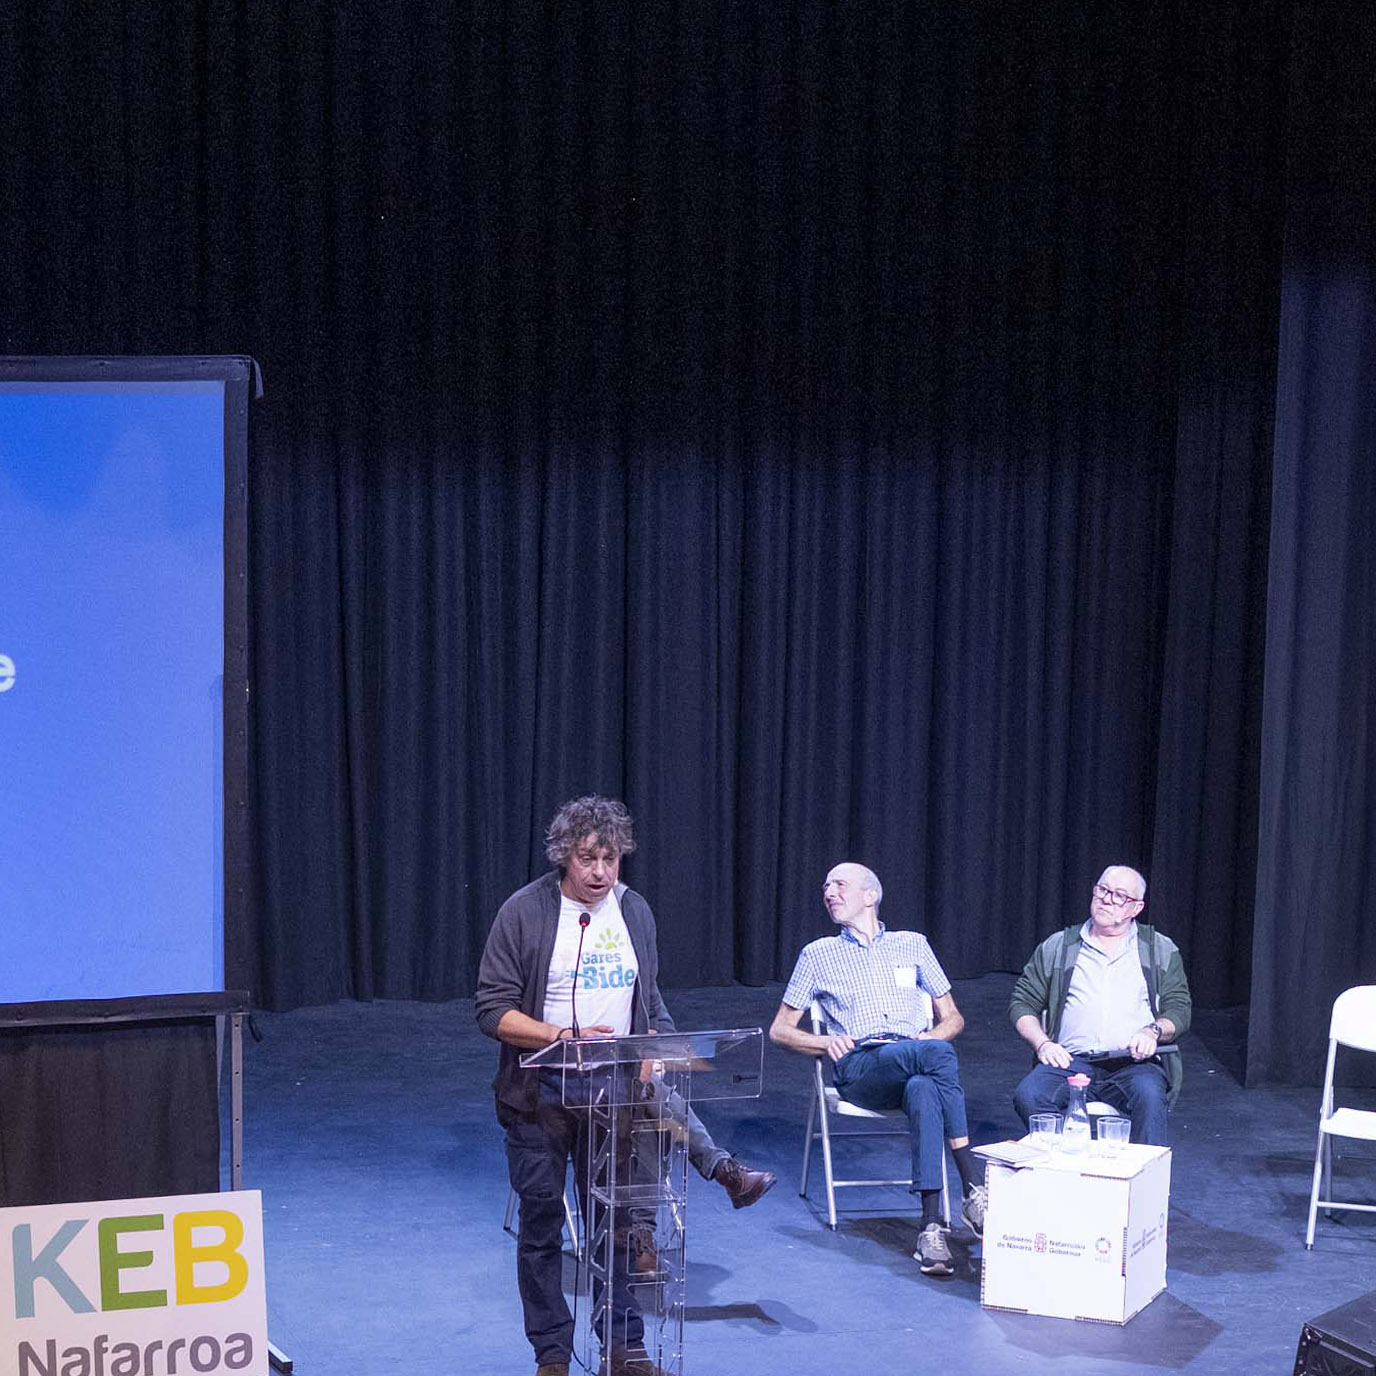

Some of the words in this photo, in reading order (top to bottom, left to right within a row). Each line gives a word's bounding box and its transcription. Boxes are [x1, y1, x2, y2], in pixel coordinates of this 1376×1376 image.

[581, 952, 622, 965] Gares
[583, 964, 635, 989] Bide
[12, 1209, 250, 1320] KEB
